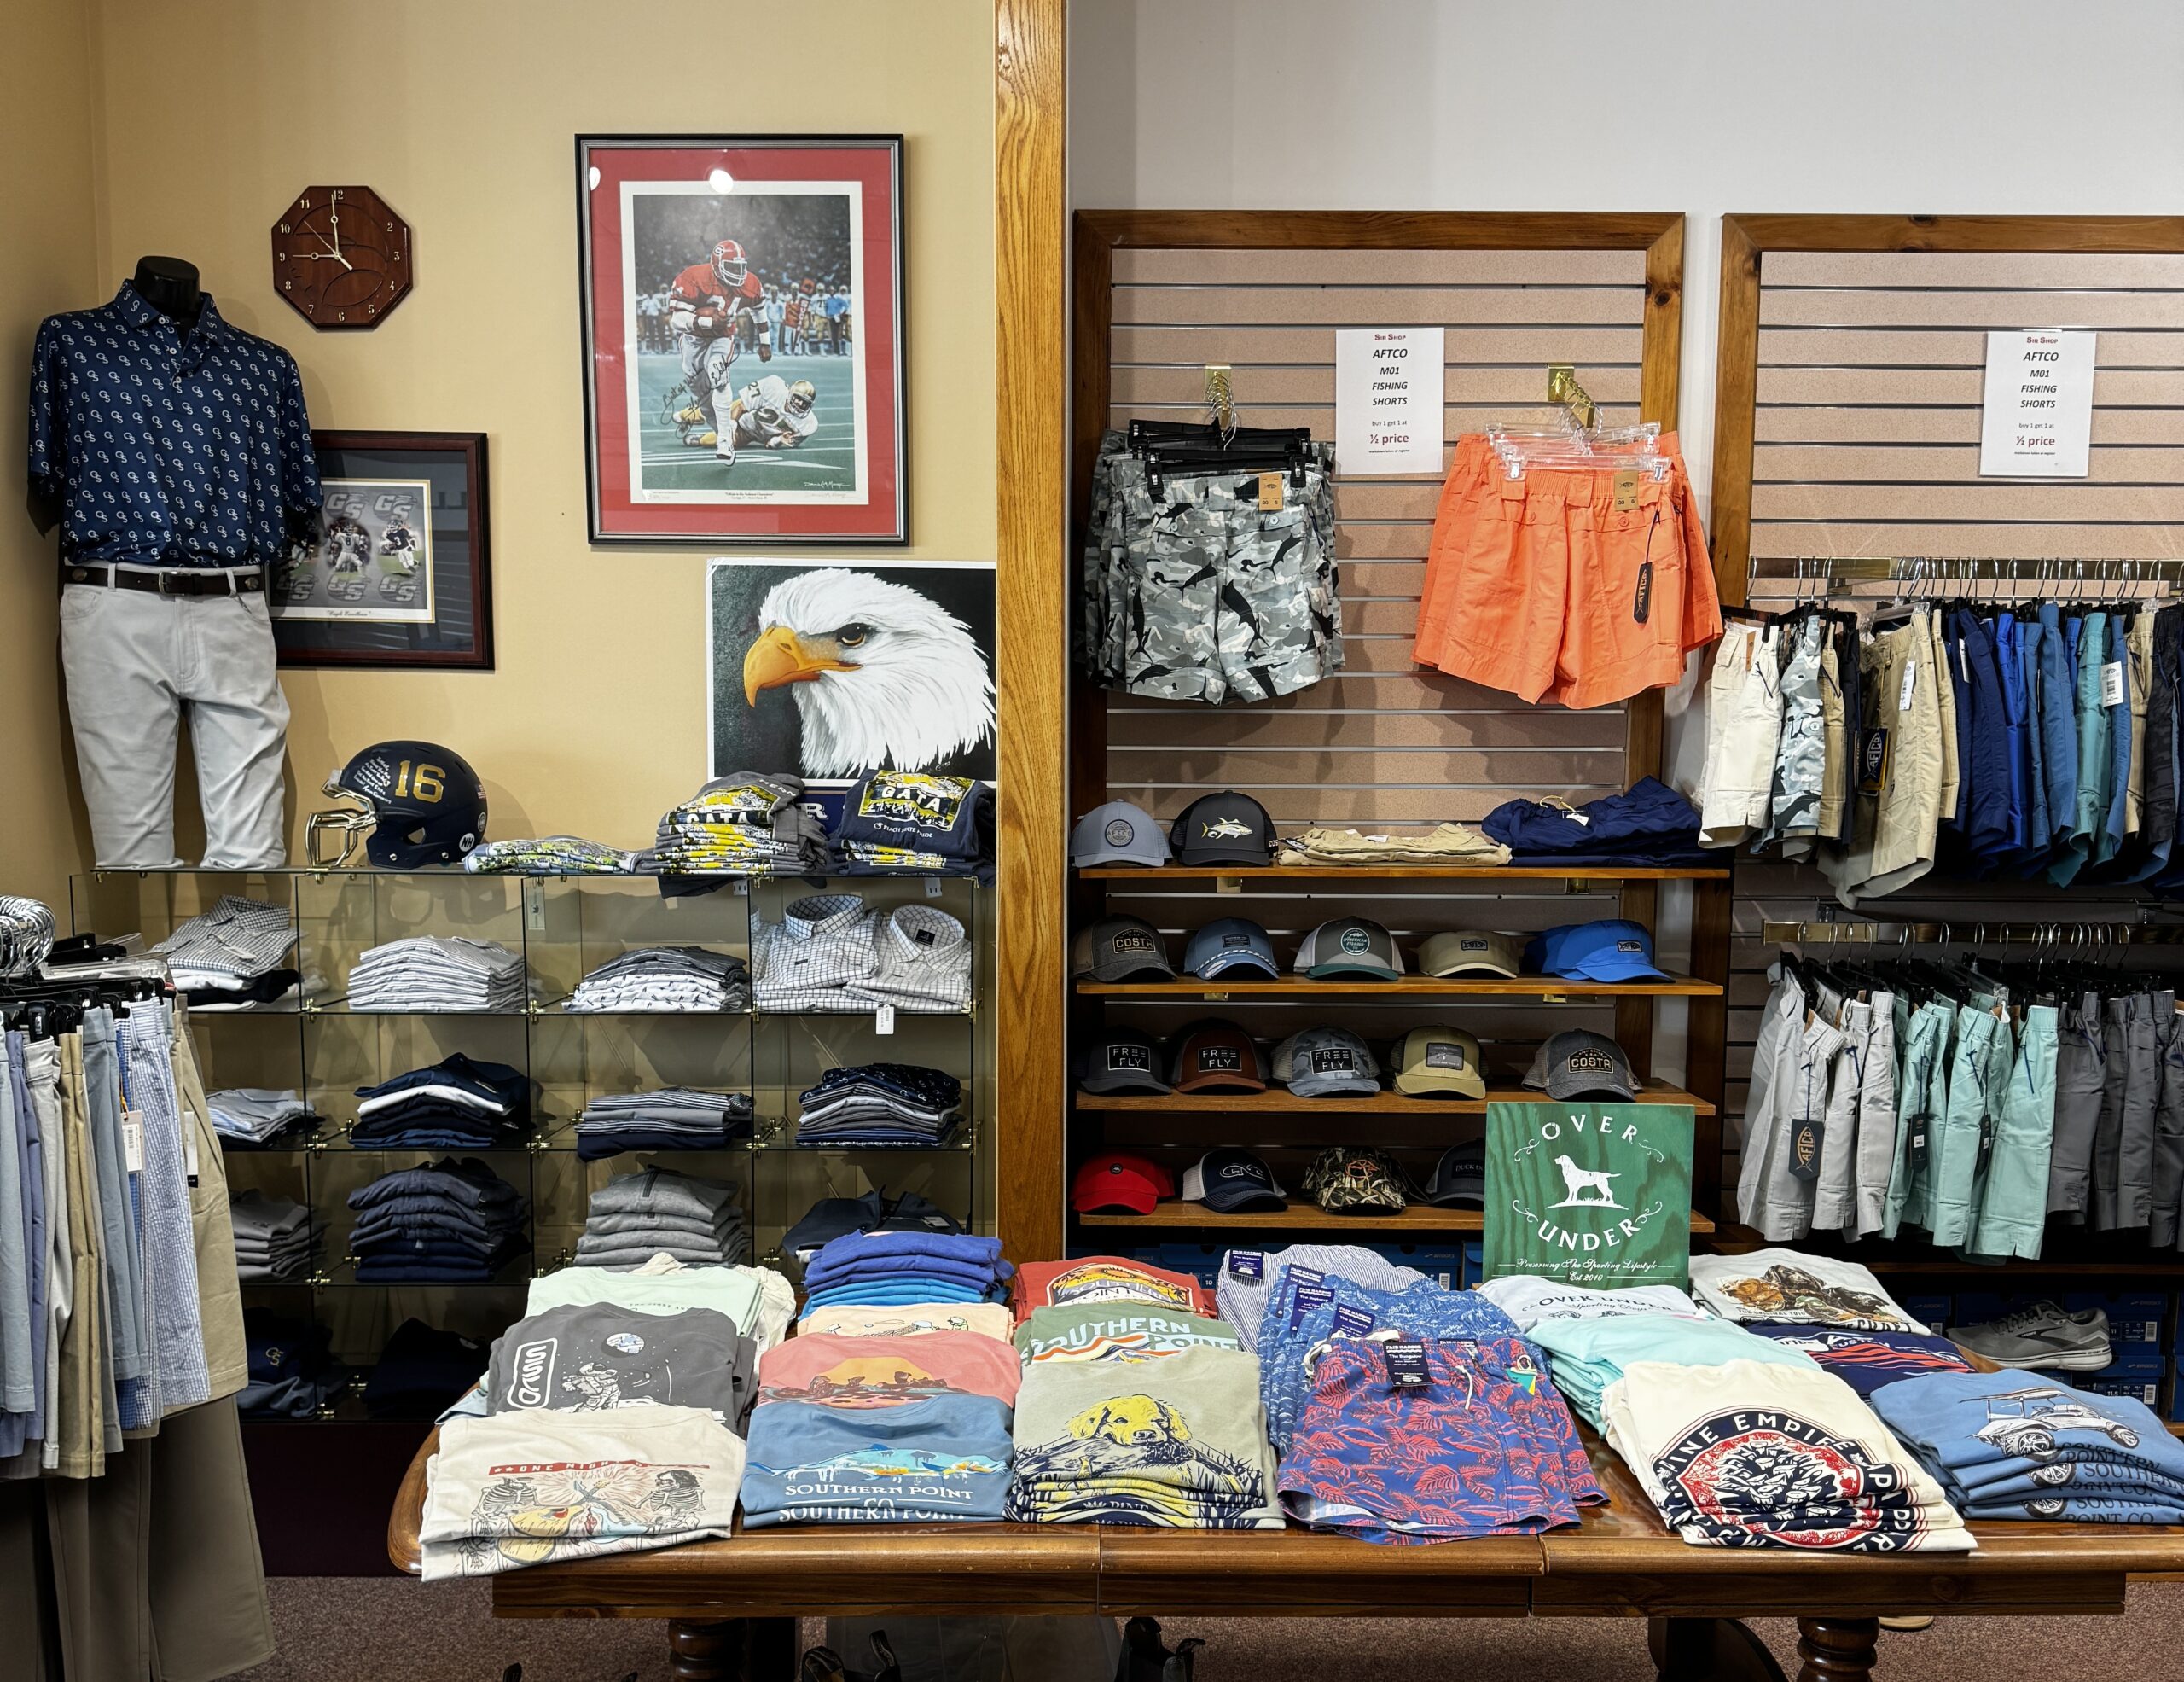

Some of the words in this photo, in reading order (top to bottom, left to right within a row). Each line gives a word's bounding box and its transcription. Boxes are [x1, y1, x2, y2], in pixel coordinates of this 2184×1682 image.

[333, 190, 344, 200] 12
[300, 199, 310, 209] 11
[281, 224, 290, 234] 10
[386, 222, 393, 232] 2
[279, 253, 286, 262] 9
[393, 251, 400, 261] 3
[285, 281, 292, 290] 8
[389, 281, 395, 291] 4
[308, 304, 314, 314] 7
[369, 304, 375, 314] 5
[338, 312, 345, 322] 6
[1373, 348, 1408, 358] AFTCO
[2023, 352, 2059, 362] AFTCO
[1380, 366, 1400, 375] M01
[2030, 370, 2049, 378] M01
[1372, 381, 1408, 391] FISHING
[2021, 385, 2057, 393] FISHING
[1373, 397, 1408, 405] SHORTS
[2020, 400, 2056, 409] SHORTS
[1382, 434, 1409, 445] price
[2028, 435, 2055, 447] price
[346, 535, 351, 546] 8
[394, 536, 402, 545] 3
[1869, 736, 1882, 768] AFTCO
[395, 760, 446, 803] 16
[881, 786, 941, 812] GATA
[461, 835, 473, 848] NH
[1116, 937, 1153, 948] COSTA
[1112, 1048, 1146, 1058] FREE
[1202, 1049, 1237, 1058] FREE
[1315, 1051, 1350, 1061] FREE
[1119, 1057, 1142, 1067] FLY
[1209, 1058, 1232, 1068] FLY
[1322, 1061, 1345, 1070] FLY
[1571, 1057, 1612, 1068] COSTA
[1541, 1114, 1638, 1144] OVER
[1800, 1131, 1815, 1161] AFTCO
[1537, 1218, 1641, 1251] UNDER
[1515, 1258, 1560, 1271] Preserving
[1560, 1258, 1582, 1269] The
[1582, 1258, 1621, 1272] Sporting
[1622, 1259, 1658, 1272] Lifestyle
[1569, 1271, 1583, 1282] Est
[1583, 1273, 1604, 1282] 2010
[1539, 1295, 1594, 1307] OVER
[265, 1347, 284, 1366] GS
[520, 1464, 554, 1472] ONE
[785, 1483, 903, 1496] SOUTHERN
[909, 1487, 974, 1499] POINT
